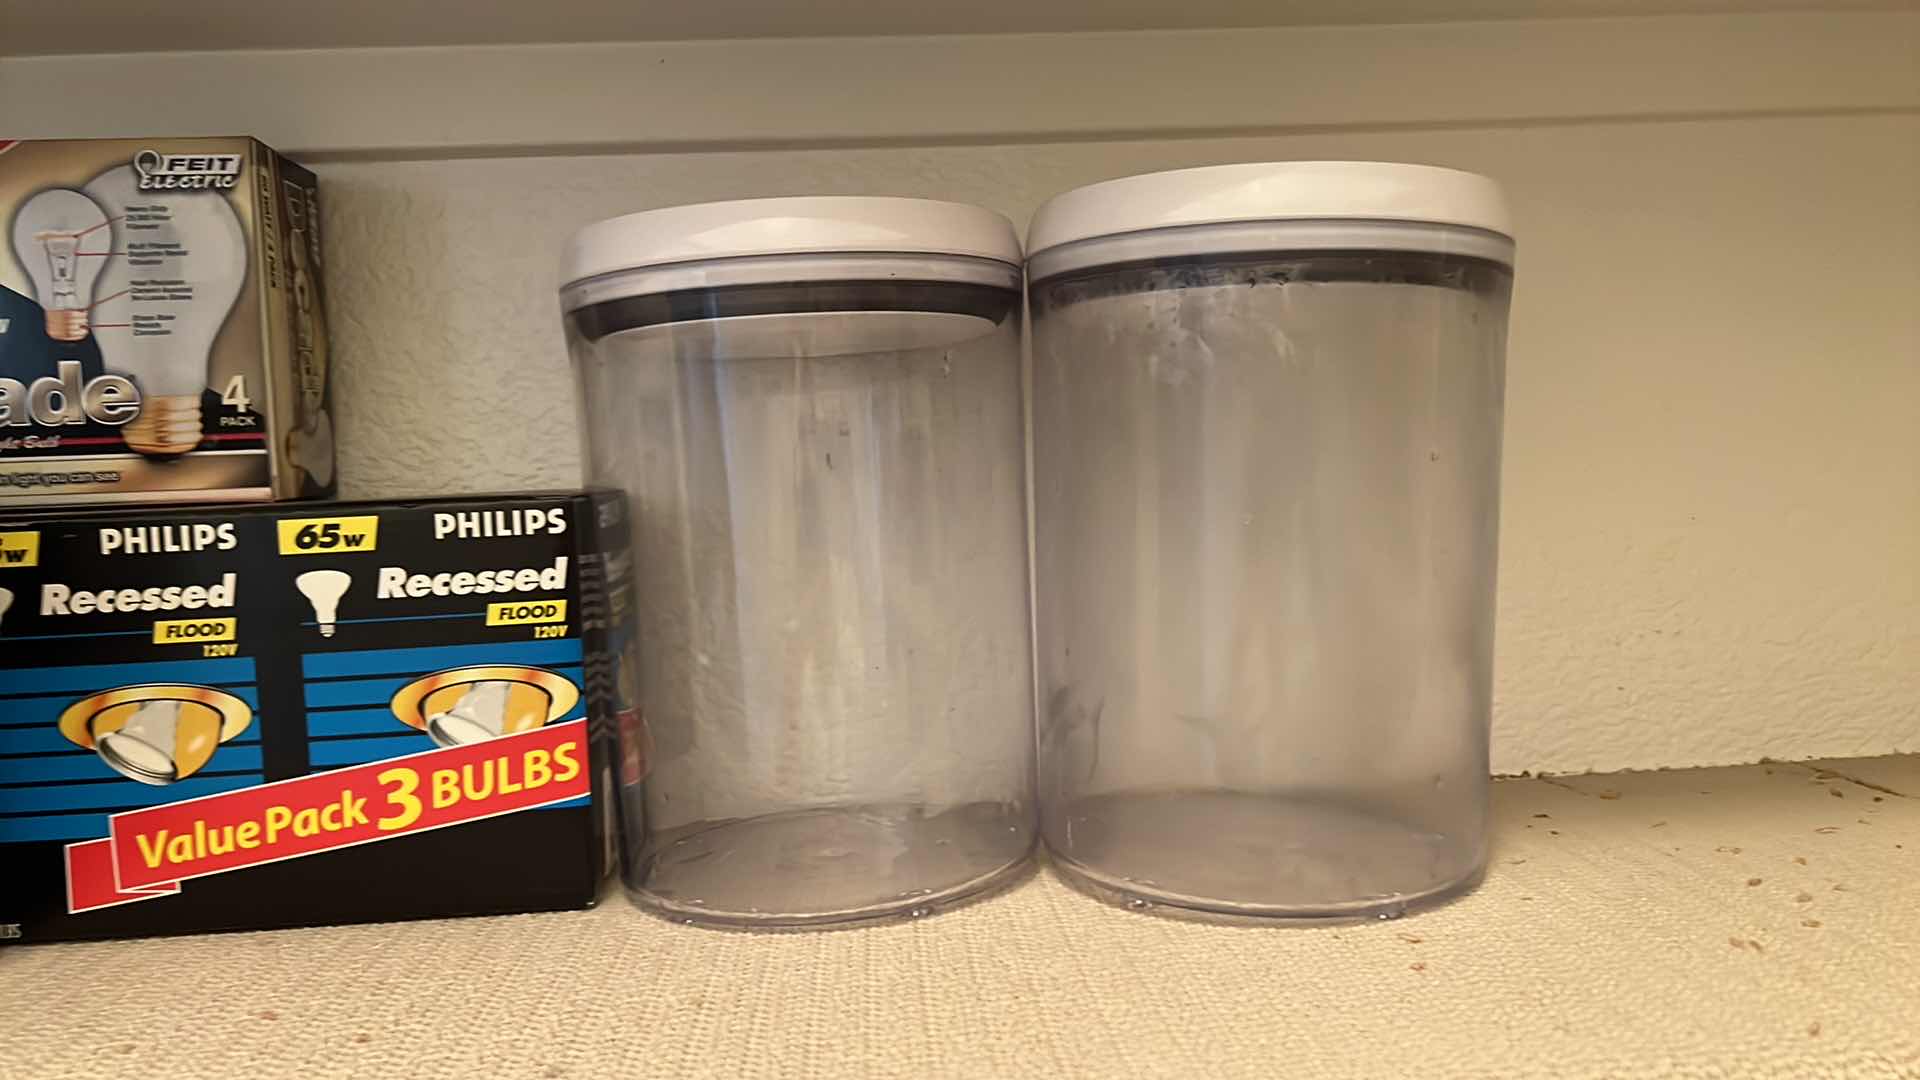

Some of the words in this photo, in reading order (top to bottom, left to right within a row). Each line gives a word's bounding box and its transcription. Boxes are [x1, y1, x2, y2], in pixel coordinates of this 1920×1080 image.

[168, 158, 233, 171] FEIT
[222, 375, 250, 412] 4
[219, 416, 257, 426] PACK
[41, 472, 68, 487] you
[69, 471, 94, 484] can
[95, 470, 120, 482] see
[433, 508, 567, 539] PHILIPS
[99, 523, 238, 555] PHILIPS
[376, 556, 568, 599] Recessed
[39, 572, 237, 616] Recessed
[498, 605, 557, 621] FLOOD
[166, 622, 227, 638] FLOOD
[534, 625, 568, 639] 120V
[203, 643, 239, 657] 120V
[376, 767, 424, 831] 3
[432, 741, 581, 809] BULBS
